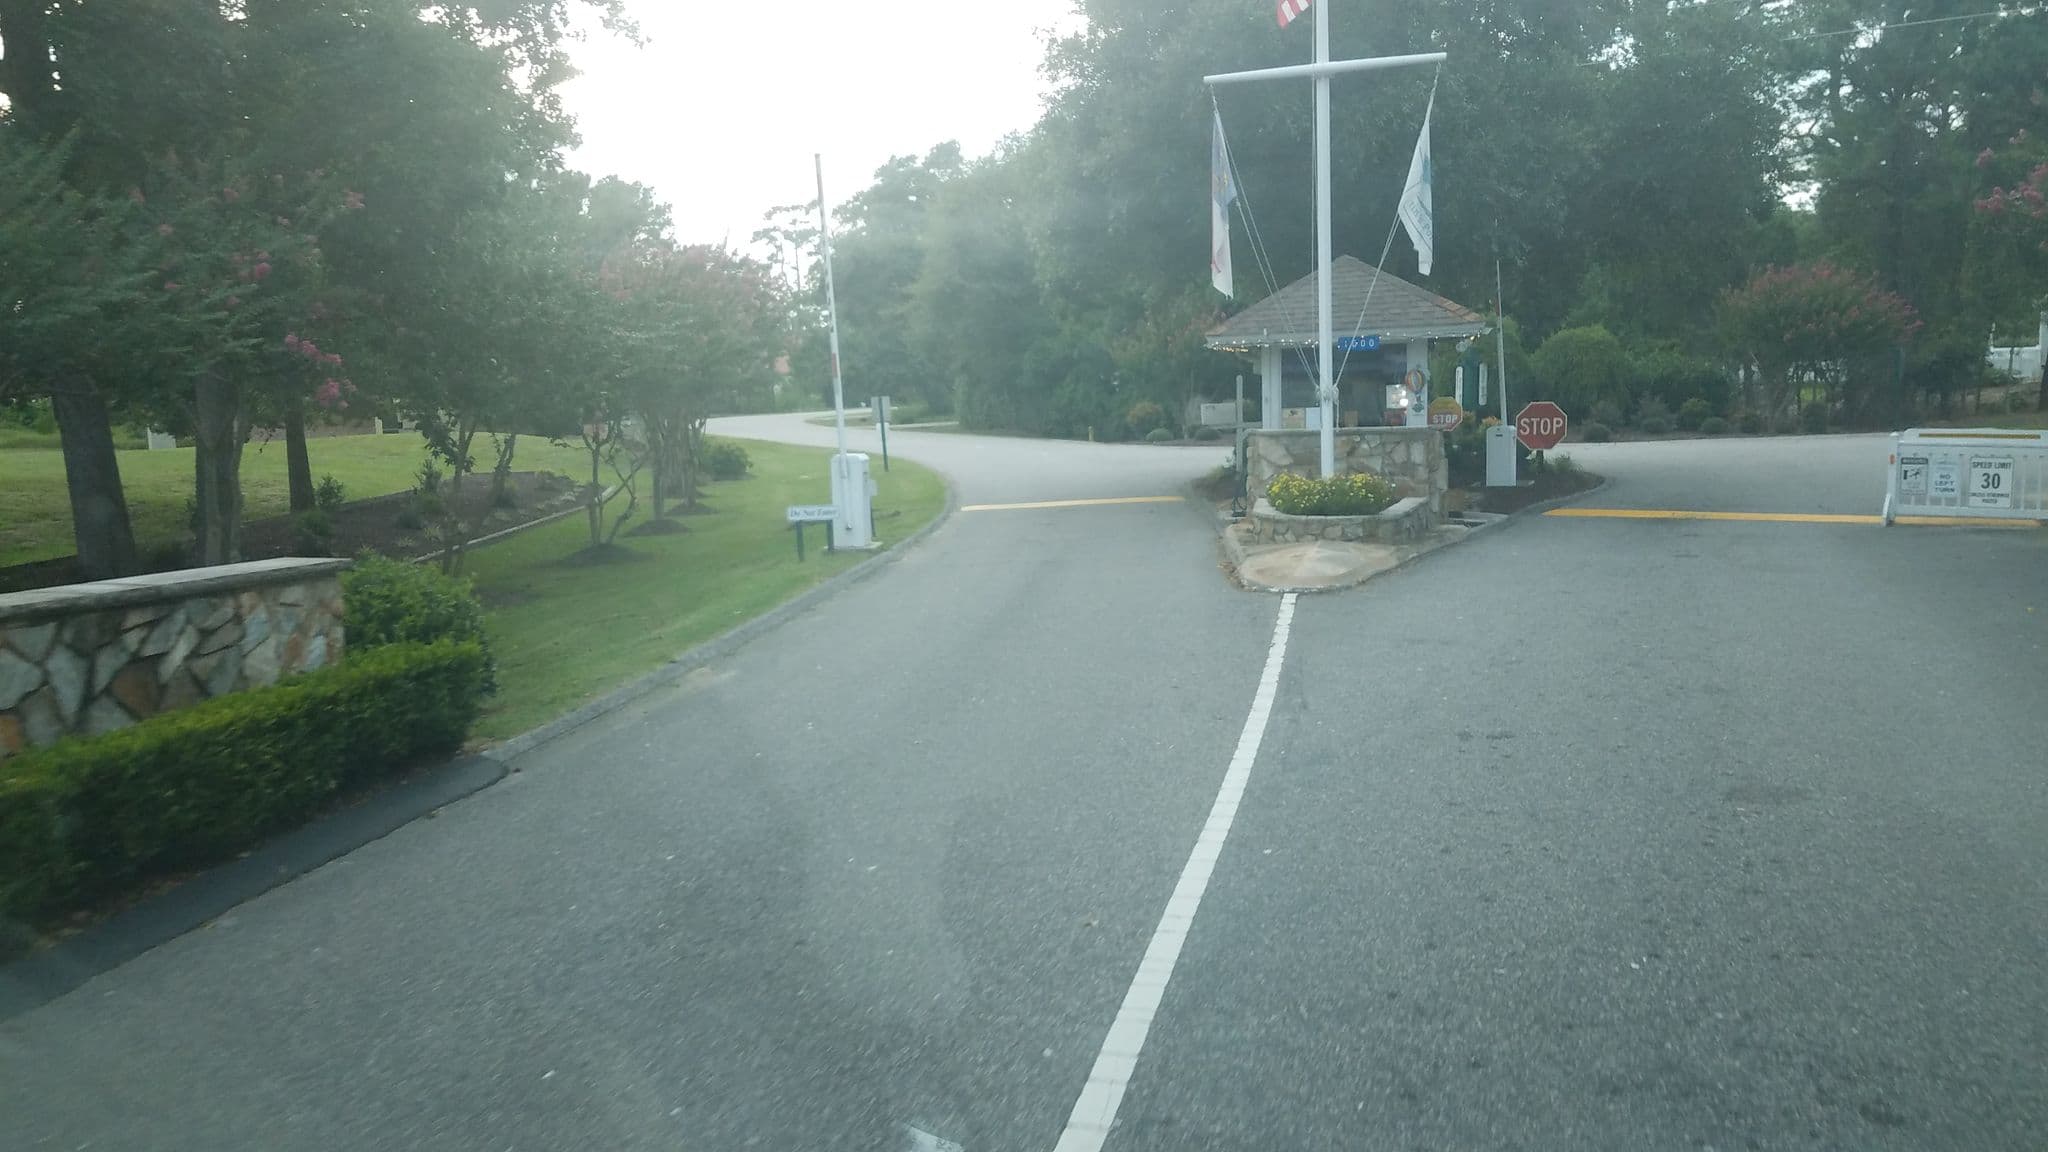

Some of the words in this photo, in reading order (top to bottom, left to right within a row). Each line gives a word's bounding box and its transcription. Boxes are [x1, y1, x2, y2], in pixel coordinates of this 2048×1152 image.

[1433, 414, 1458, 424] STOP
[1520, 418, 1563, 436] STOP
[1972, 461, 1992, 469] SPEED
[1994, 461, 2011, 469] LIMIT
[1981, 472, 2000, 489] 30
